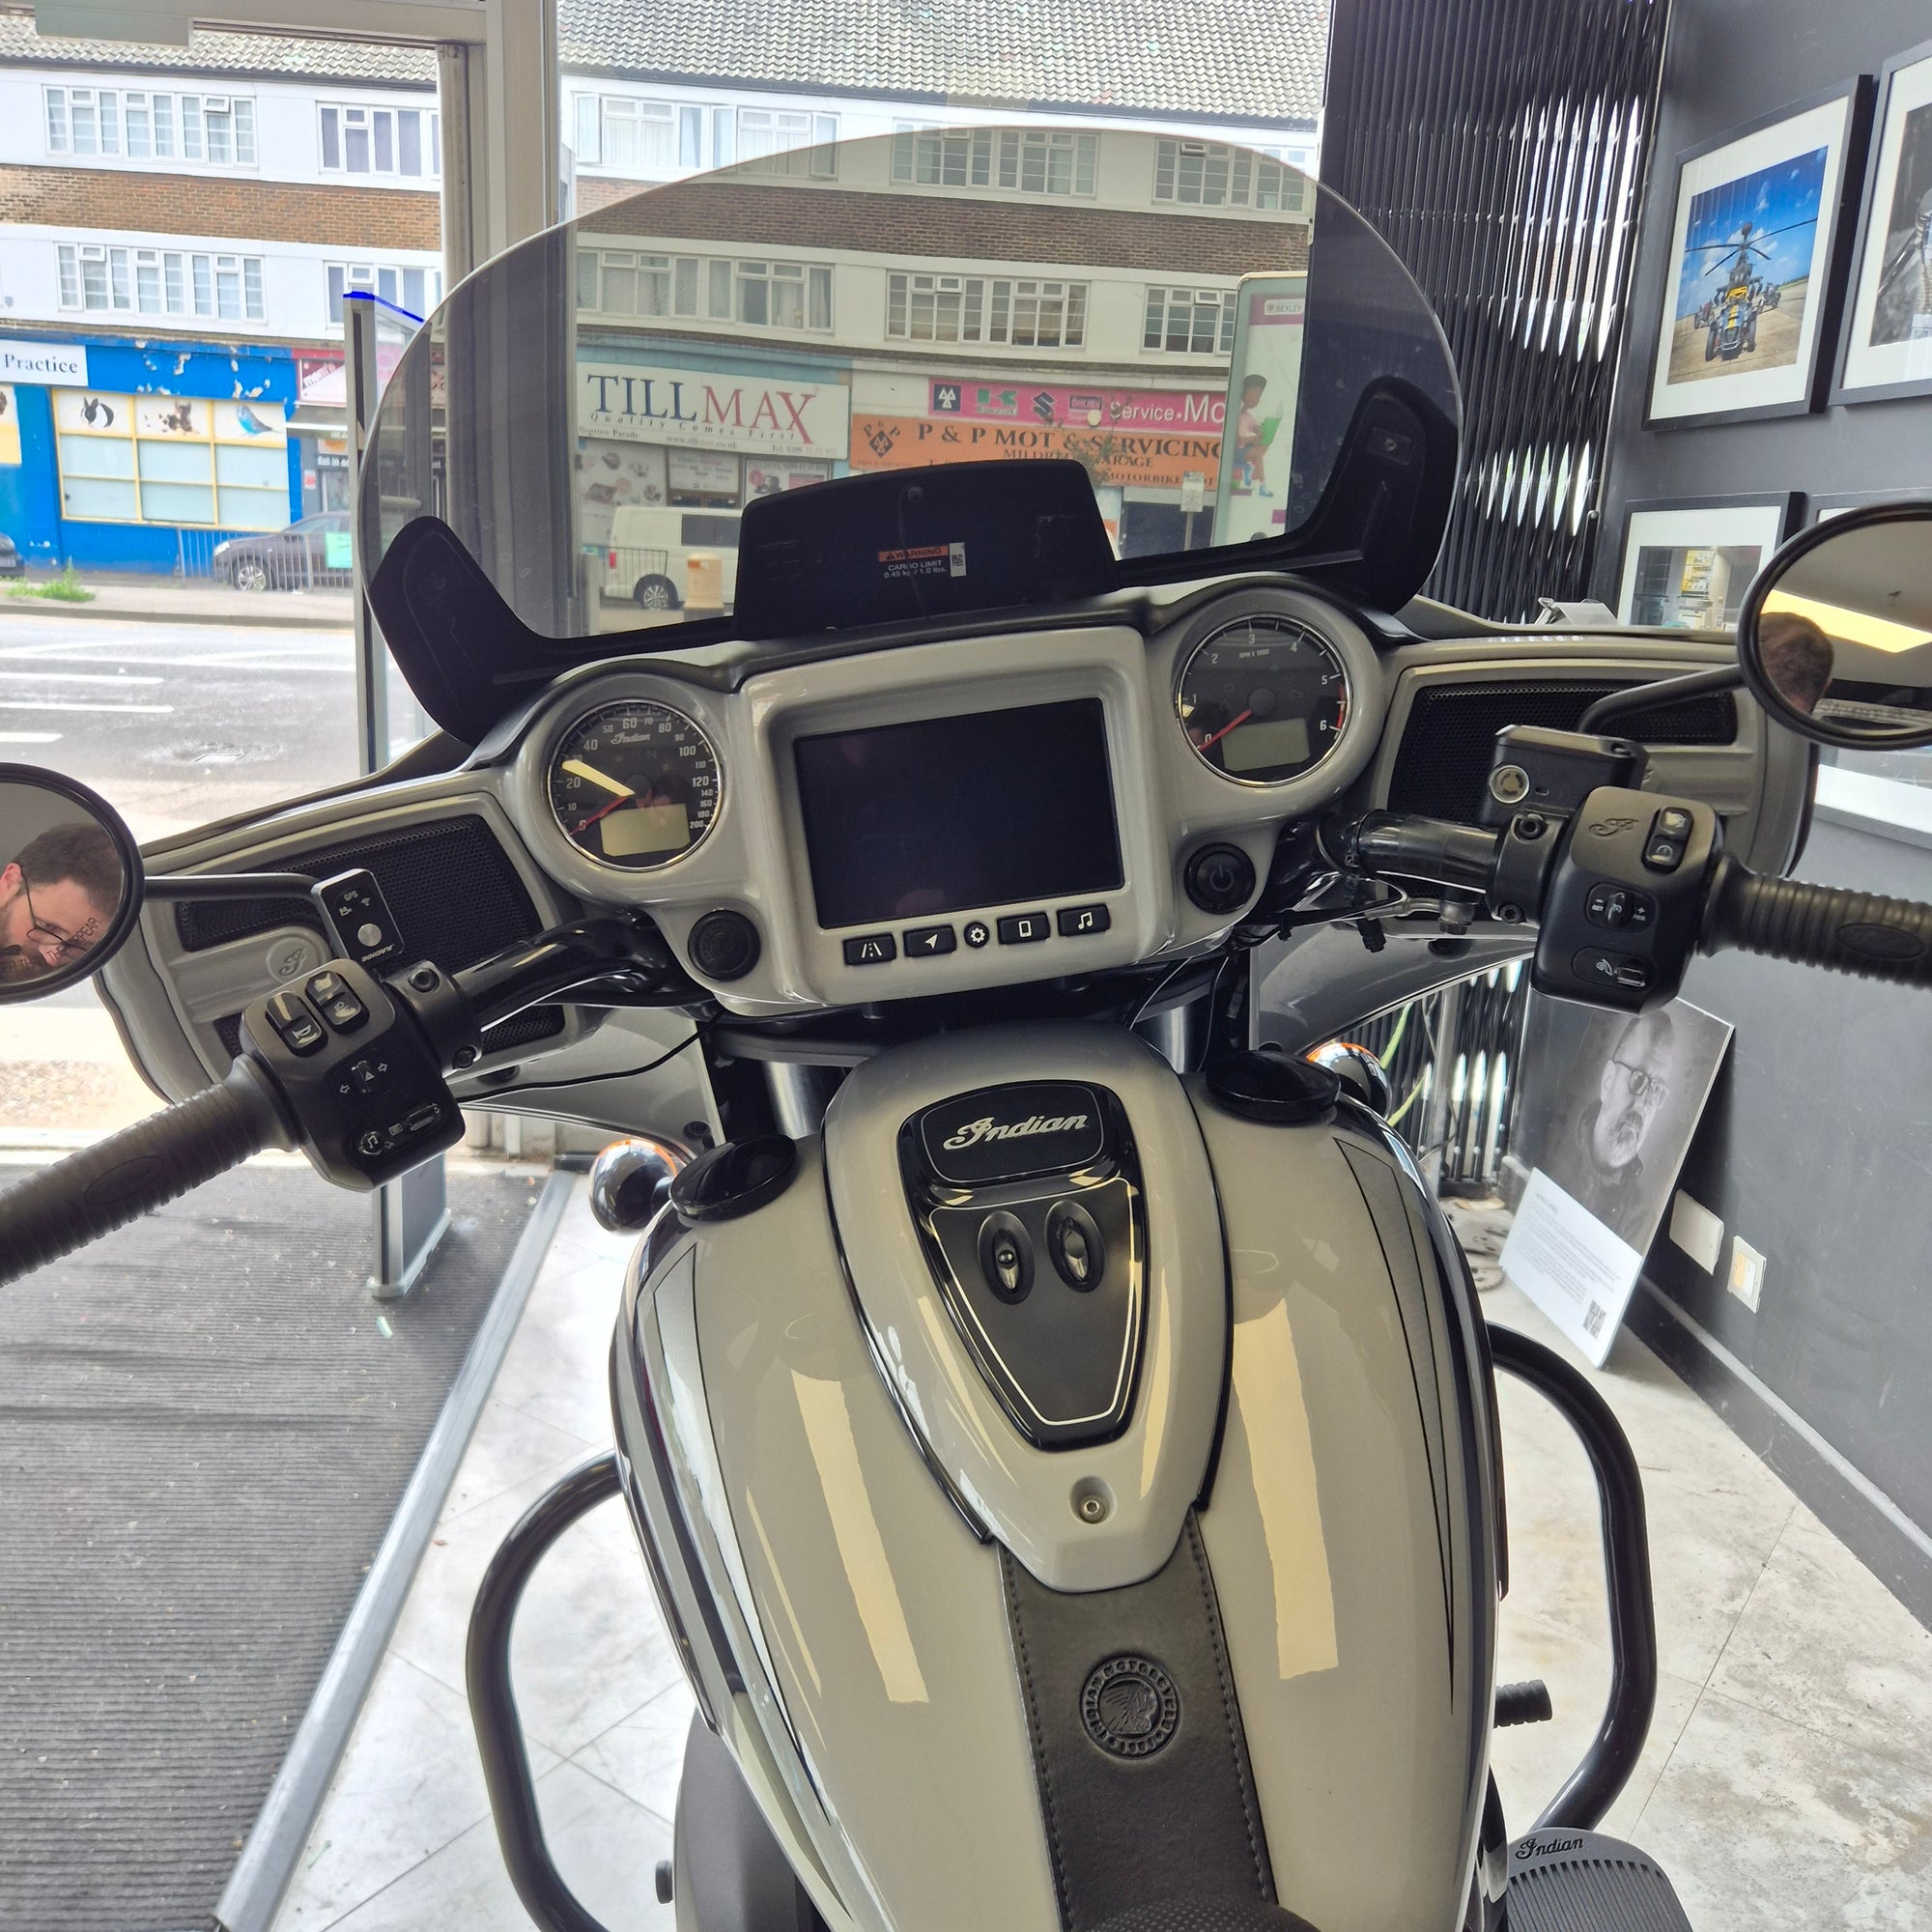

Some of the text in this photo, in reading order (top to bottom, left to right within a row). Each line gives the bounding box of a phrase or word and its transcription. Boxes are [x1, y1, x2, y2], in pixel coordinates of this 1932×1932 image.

[5, 354, 78, 374] Practice
[587, 374, 817, 444] TILLMAX
[1111, 401, 1175, 421] Service
[590, 412, 796, 440] Quality Comes First
[919, 423, 933, 440] P
[941, 425, 962, 443] &
[972, 427, 986, 444] P
[995, 429, 1055, 448] MOT
[1099, 455, 1153, 468] ARAGE
[894, 548, 943, 559] WARNING
[920, 559, 943, 568] LIMIT
[884, 570, 901, 579] 0.45
[1248, 634, 1256, 644] 3
[1290, 641, 1298, 653] 4
[1211, 653, 1219, 665] 2
[1321, 675, 1328, 685] 5
[1192, 694, 1197, 703] 1
[622, 717, 638, 729] 60
[643, 717, 654, 725] 70
[1320, 720, 1327, 730] 6
[602, 724, 614, 733] 50
[658, 722, 672, 733] 80
[611, 731, 651, 745] Indian
[674, 733, 685, 742] 90
[582, 739, 599, 751] 40
[678, 745, 696, 757] 100
[695, 760, 706, 770] 110
[566, 777, 582, 789] 20
[692, 776, 710, 787] 120
[701, 788, 714, 797] 140
[567, 803, 577, 811] 10
[699, 799, 713, 808] 160
[696, 810, 710, 819] 180
[689, 820, 705, 830] 200
[943, 1114, 1089, 1151] Indian
[1515, 1837, 1585, 1861] Indian
